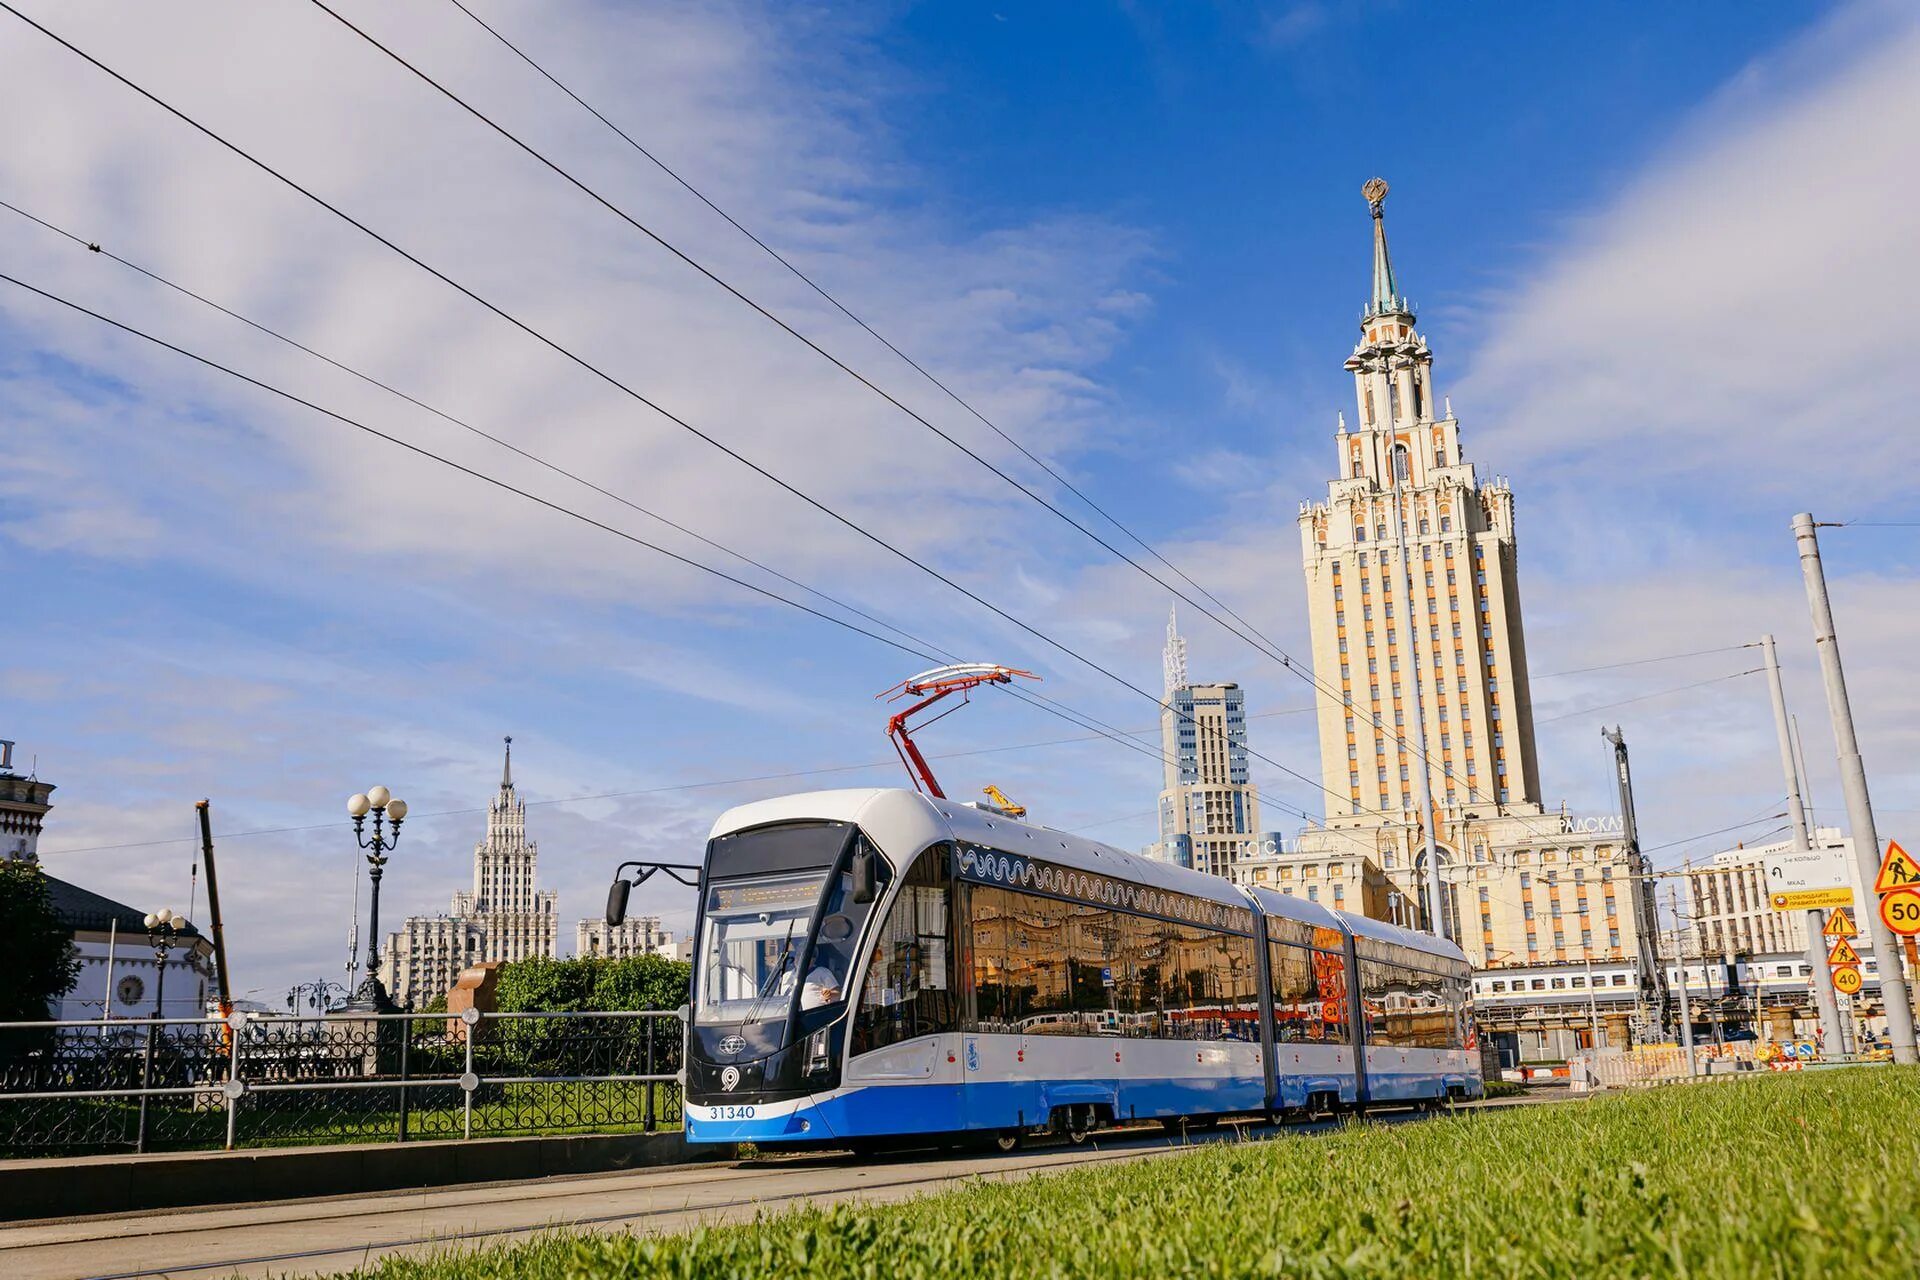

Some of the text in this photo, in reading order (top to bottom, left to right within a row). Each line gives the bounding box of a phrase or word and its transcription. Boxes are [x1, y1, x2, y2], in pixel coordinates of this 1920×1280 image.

[1788, 892, 1830, 901] СОБЛЮДАЙТЕ
[1892, 903, 1920, 921] 50
[1838, 974, 1856, 985] 40
[710, 1105, 755, 1120] 31340
